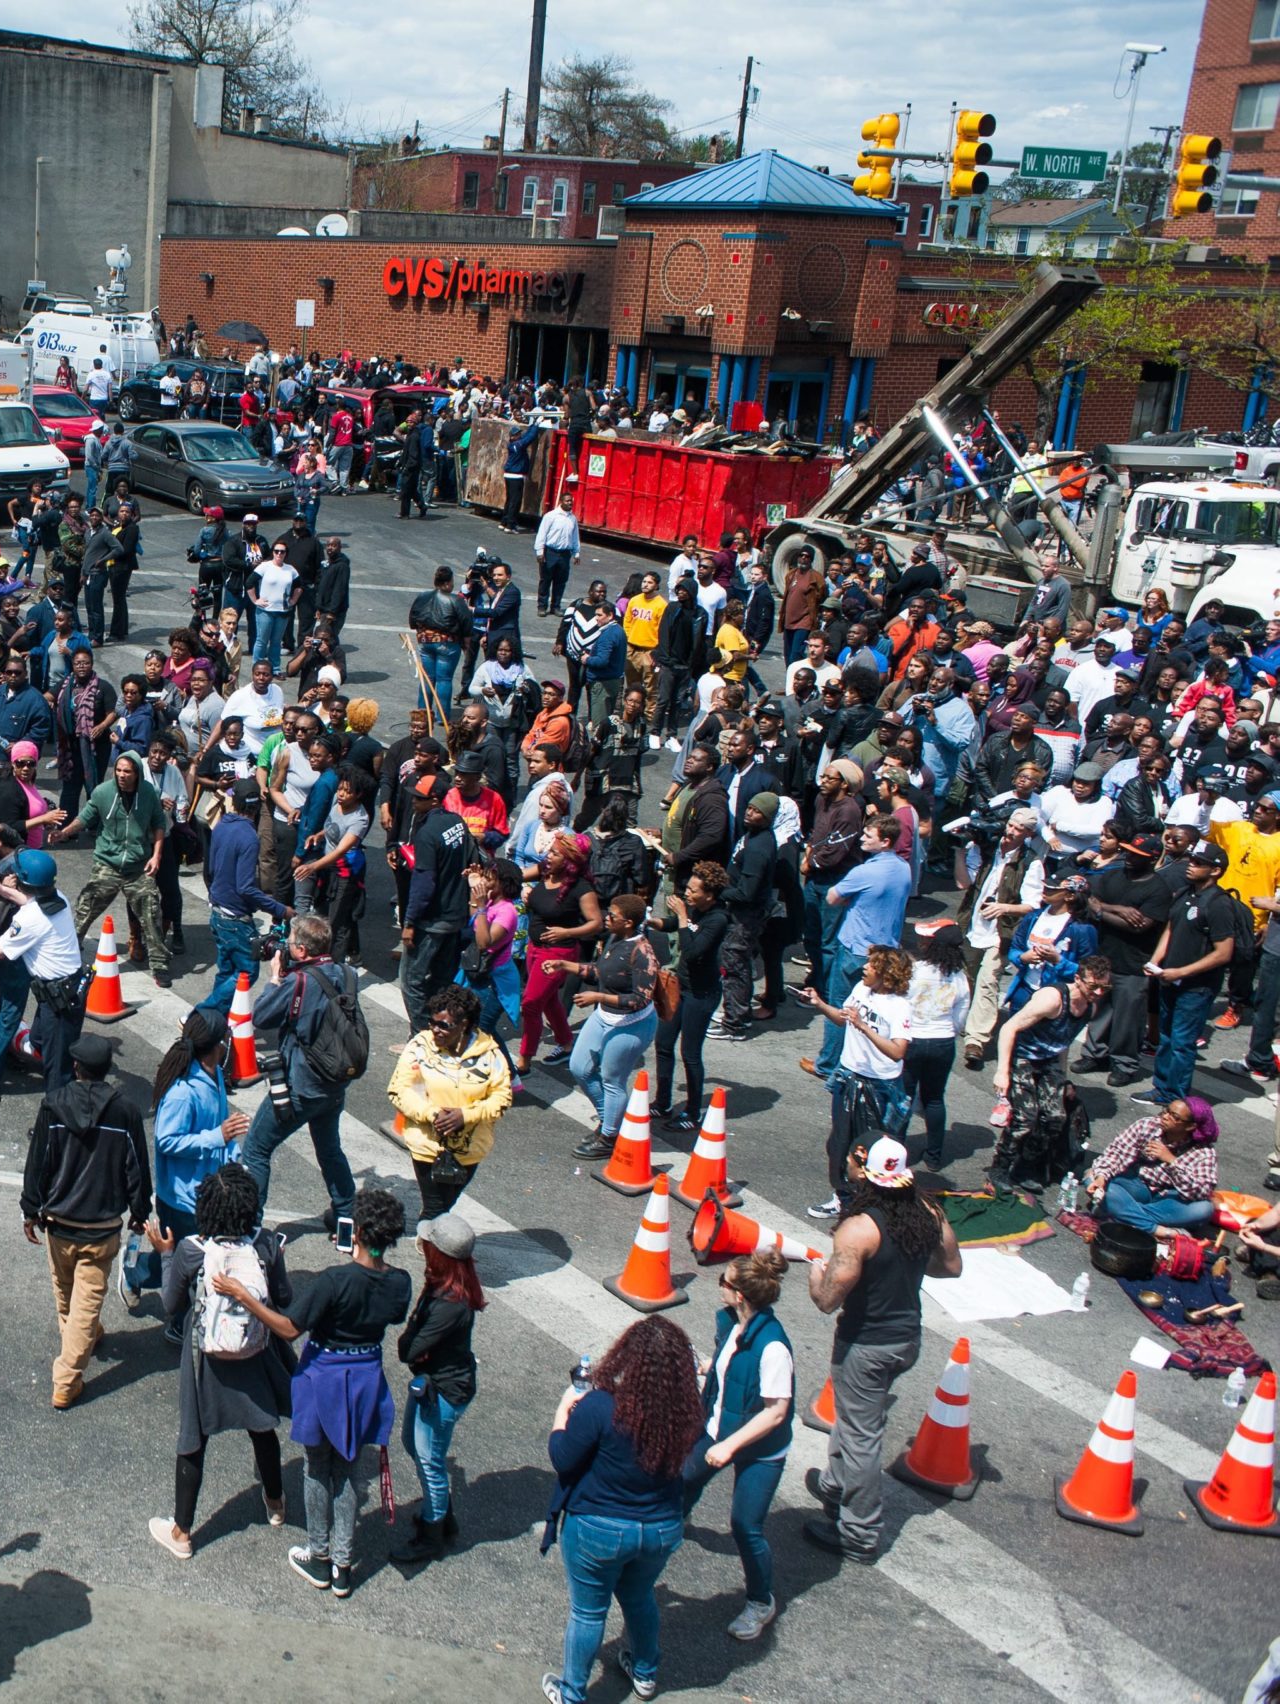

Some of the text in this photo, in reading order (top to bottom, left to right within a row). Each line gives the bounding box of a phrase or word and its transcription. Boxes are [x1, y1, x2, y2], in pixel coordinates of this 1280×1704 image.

[1026, 153, 1038, 171] W.
[1043, 154, 1081, 174] NORTH
[58, 344, 78, 353] WJZ
